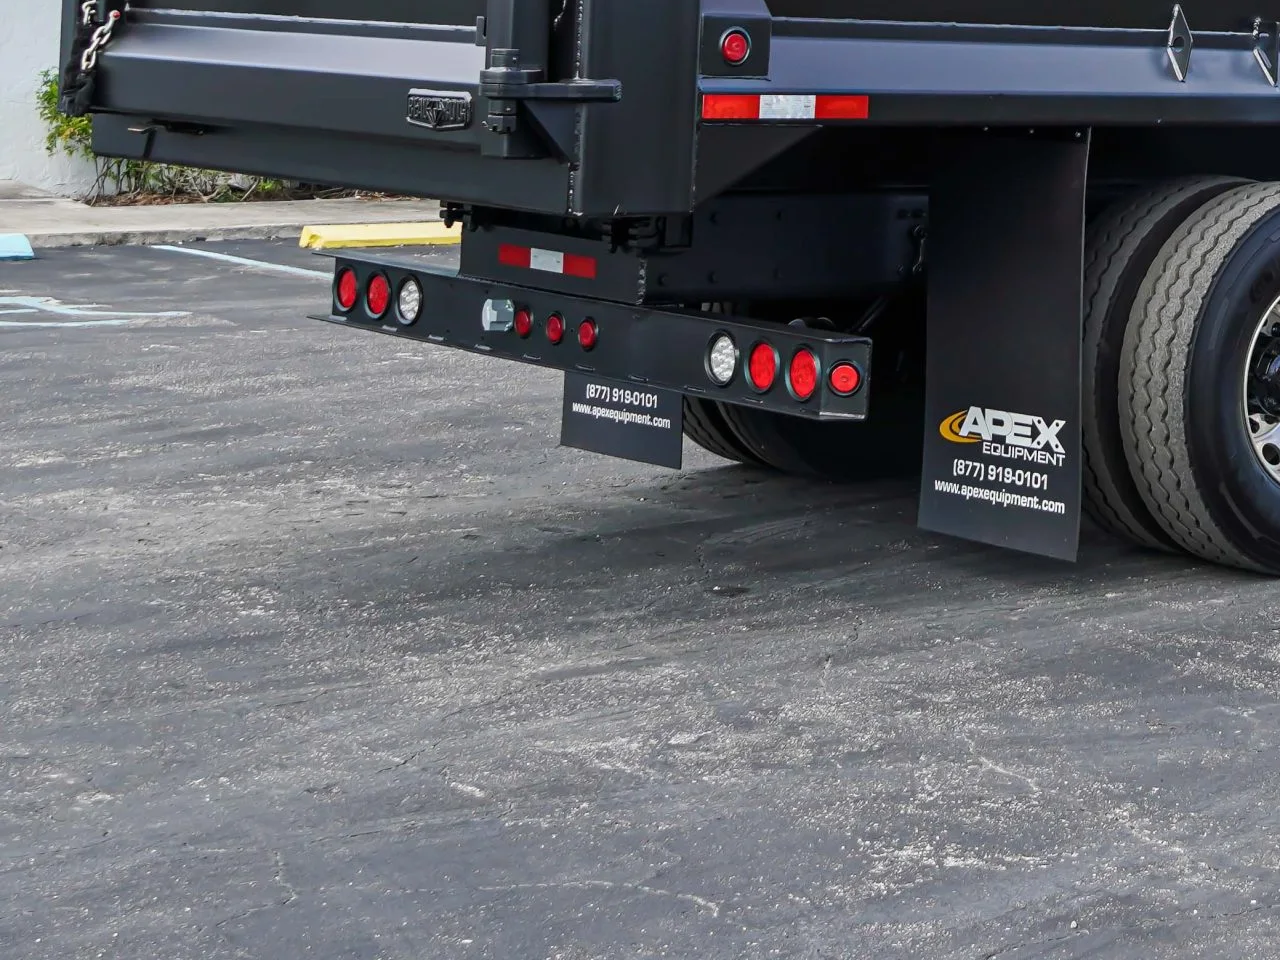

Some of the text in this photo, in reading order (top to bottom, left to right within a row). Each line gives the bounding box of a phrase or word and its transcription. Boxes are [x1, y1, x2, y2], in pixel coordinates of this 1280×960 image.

[585, 383, 658, 409] (877) 919-0101
[572, 402, 671, 429] www.apexequipment.com
[958, 406, 1066, 453] APEX
[982, 442, 1066, 467] EQUIPMENT
[953, 458, 1048, 490] (877) 919-0101
[934, 479, 1066, 514] www.apexequipment.com
